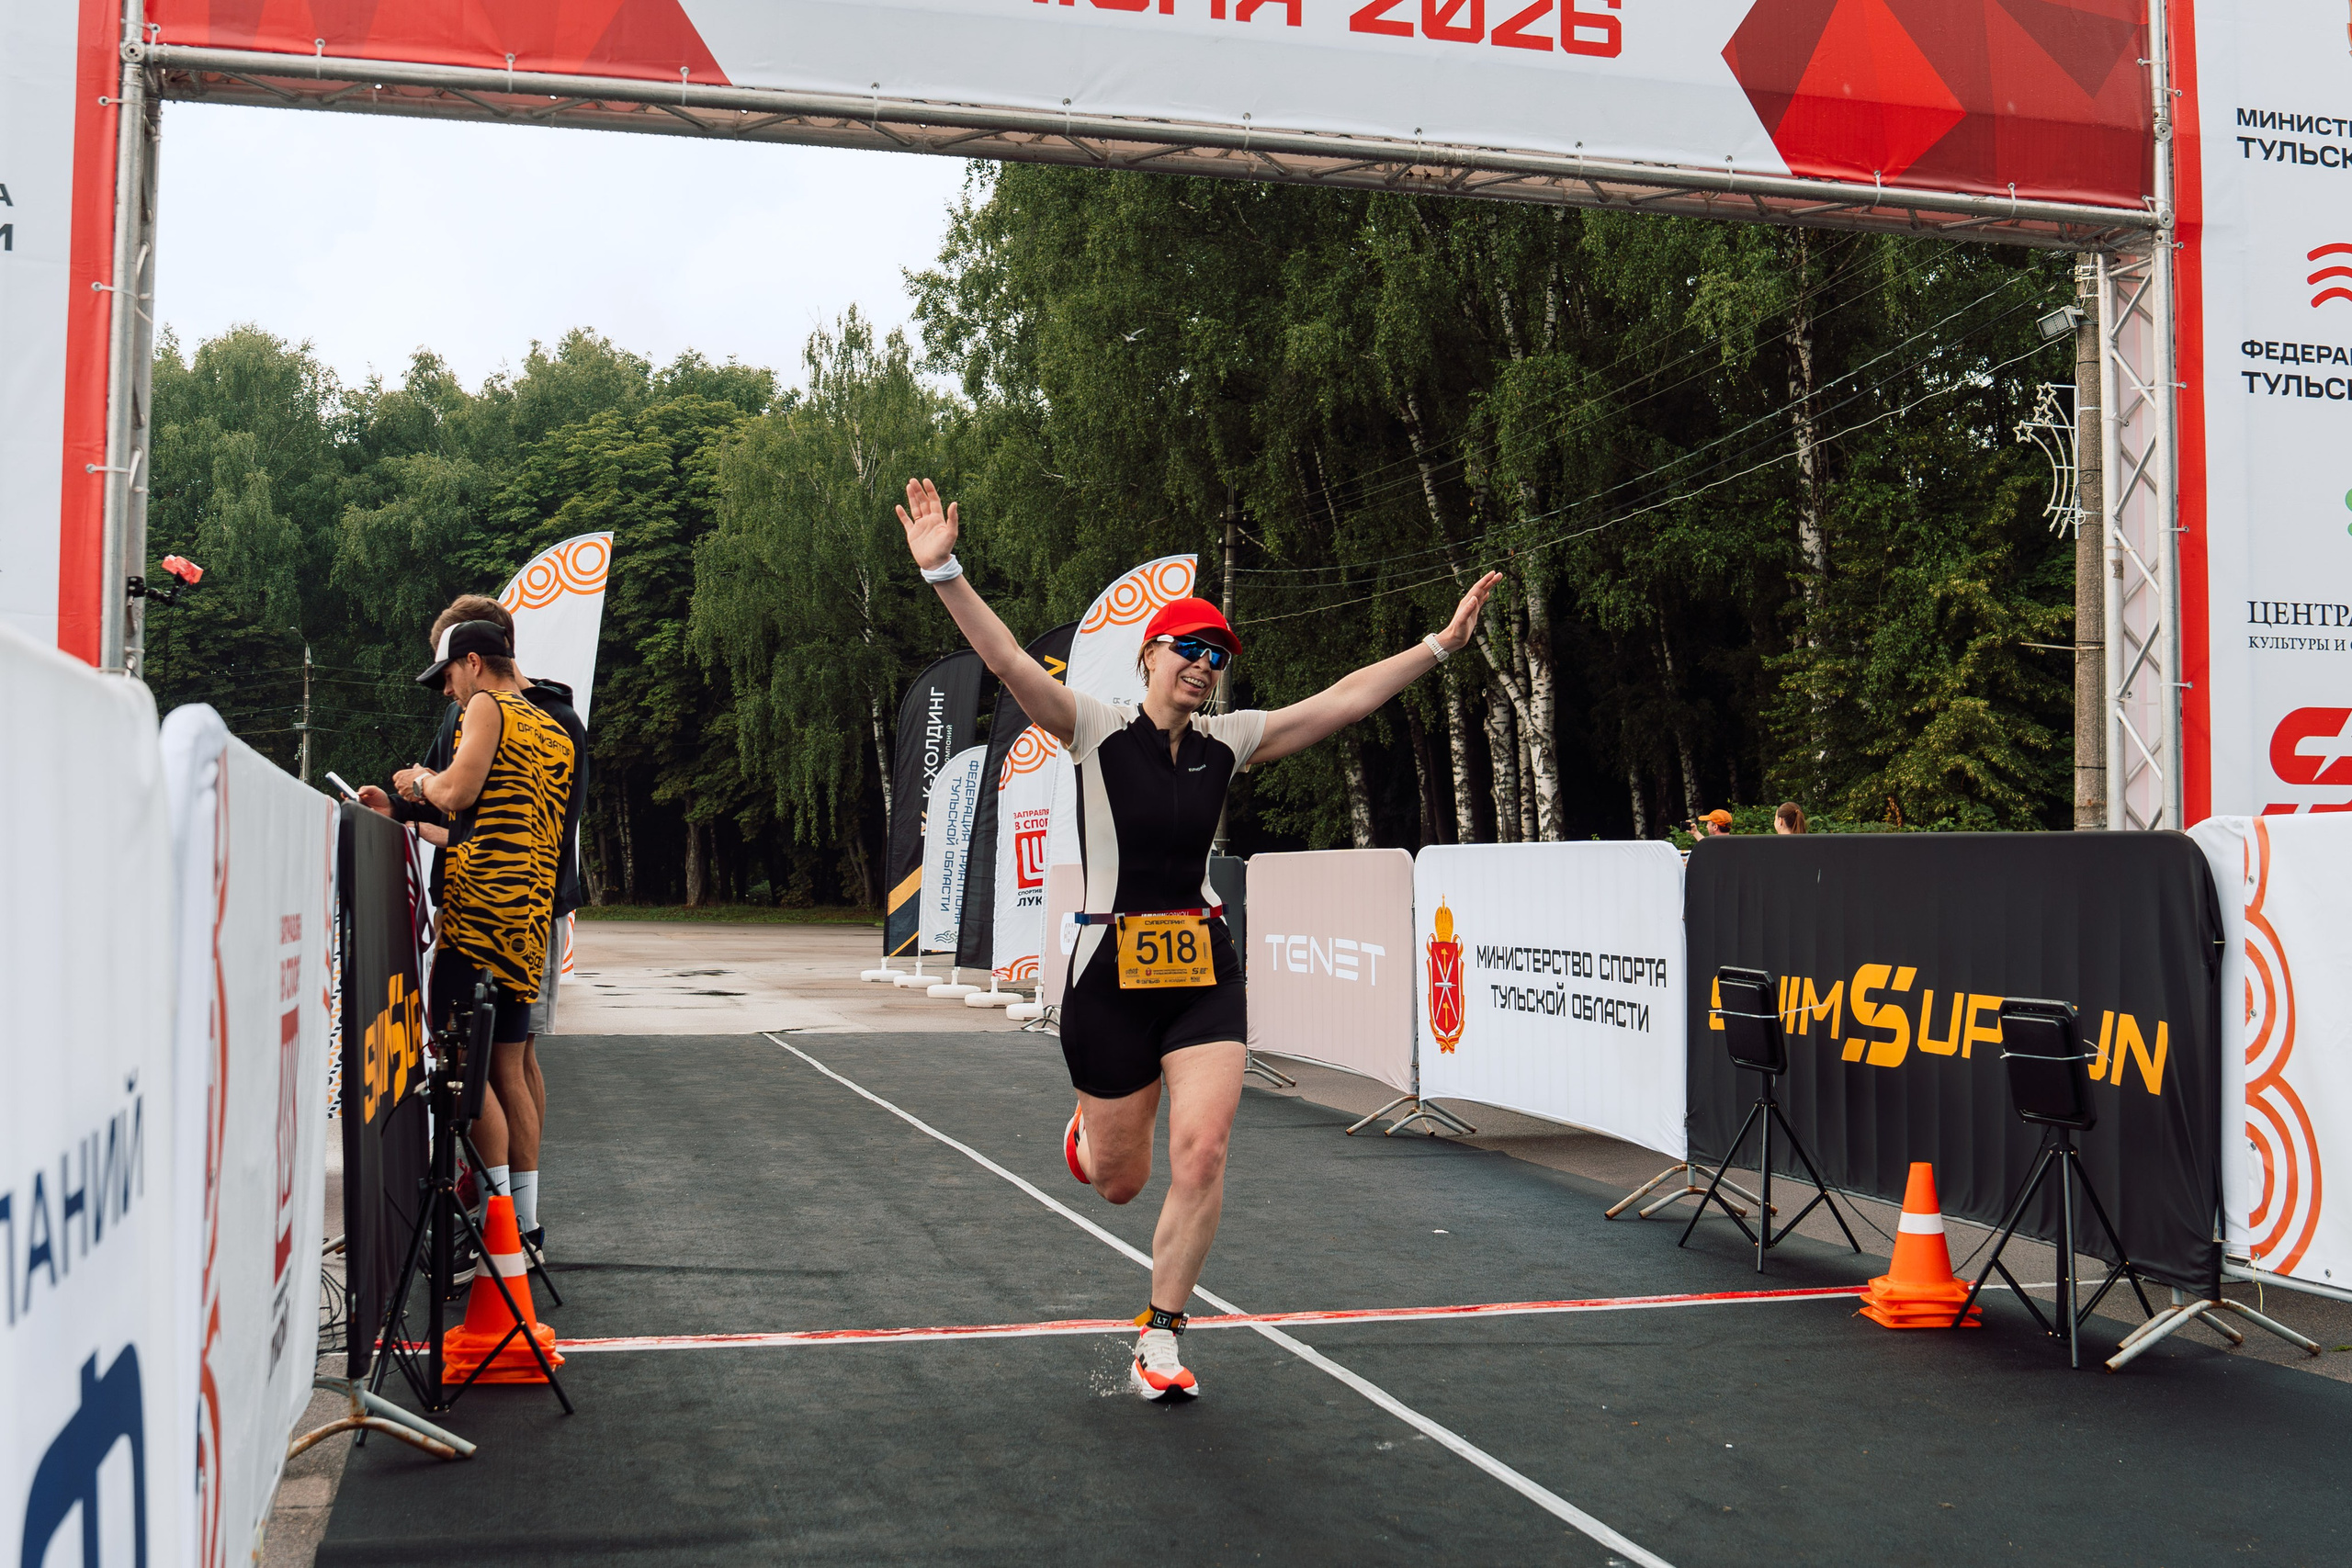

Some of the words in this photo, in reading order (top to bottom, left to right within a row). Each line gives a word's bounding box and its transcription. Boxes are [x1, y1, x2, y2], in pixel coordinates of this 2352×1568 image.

[2236, 107, 2352, 138] МИНИСТ
[2241, 339, 2352, 366] ФЕДЕРА
[2241, 370, 2352, 400] ТУЛЬС
[2246, 601, 2352, 628] ЦЕНТР
[2248, 636, 2330, 650] КУЛЬТУРЫ
[2334, 639, 2346, 651] И
[944, 724, 953, 765] омпаний
[946, 776, 963, 846] ТУЛЬСКОЙ
[961, 760, 979, 842] ФЕДЕРАЦИЯ
[940, 851, 956, 912] ОБЛАСТИ
[1136, 930, 1197, 964] 518
[1265, 934, 1385, 986] TENET
[1476, 945, 1593, 978] МИНИСТЕРСТВО
[1599, 953, 1668, 988] СПОРТА
[1490, 981, 1566, 1017] ТУЛЬСКОЙ
[1572, 993, 1650, 1033] ОБЛАСТИ
